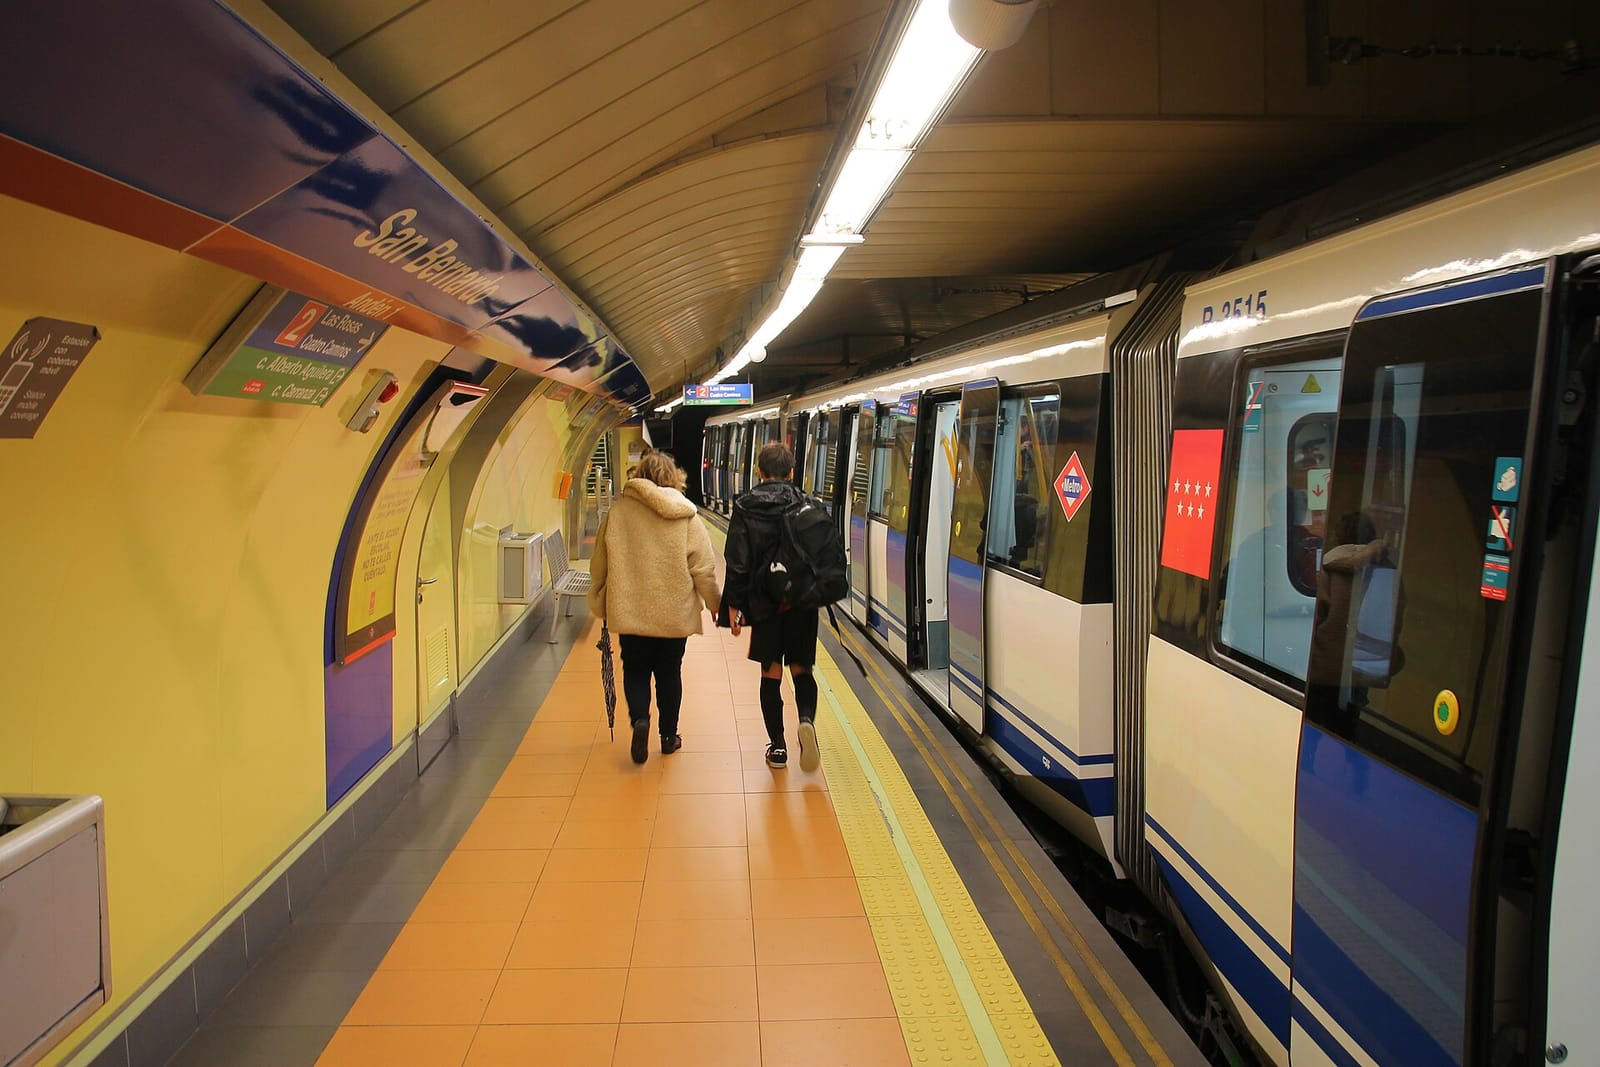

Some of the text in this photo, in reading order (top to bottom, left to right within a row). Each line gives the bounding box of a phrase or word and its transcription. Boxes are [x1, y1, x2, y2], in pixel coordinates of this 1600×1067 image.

[353, 208, 505, 305] San Bernardo
[284, 307, 317, 341] 2
[320, 308, 365, 334] Las Rosas
[300, 333, 325, 353] Cuatro
[267, 356, 302, 375] Alberto
[299, 361, 335, 381] Aguilera
[1063, 477, 1081, 494] Metro
